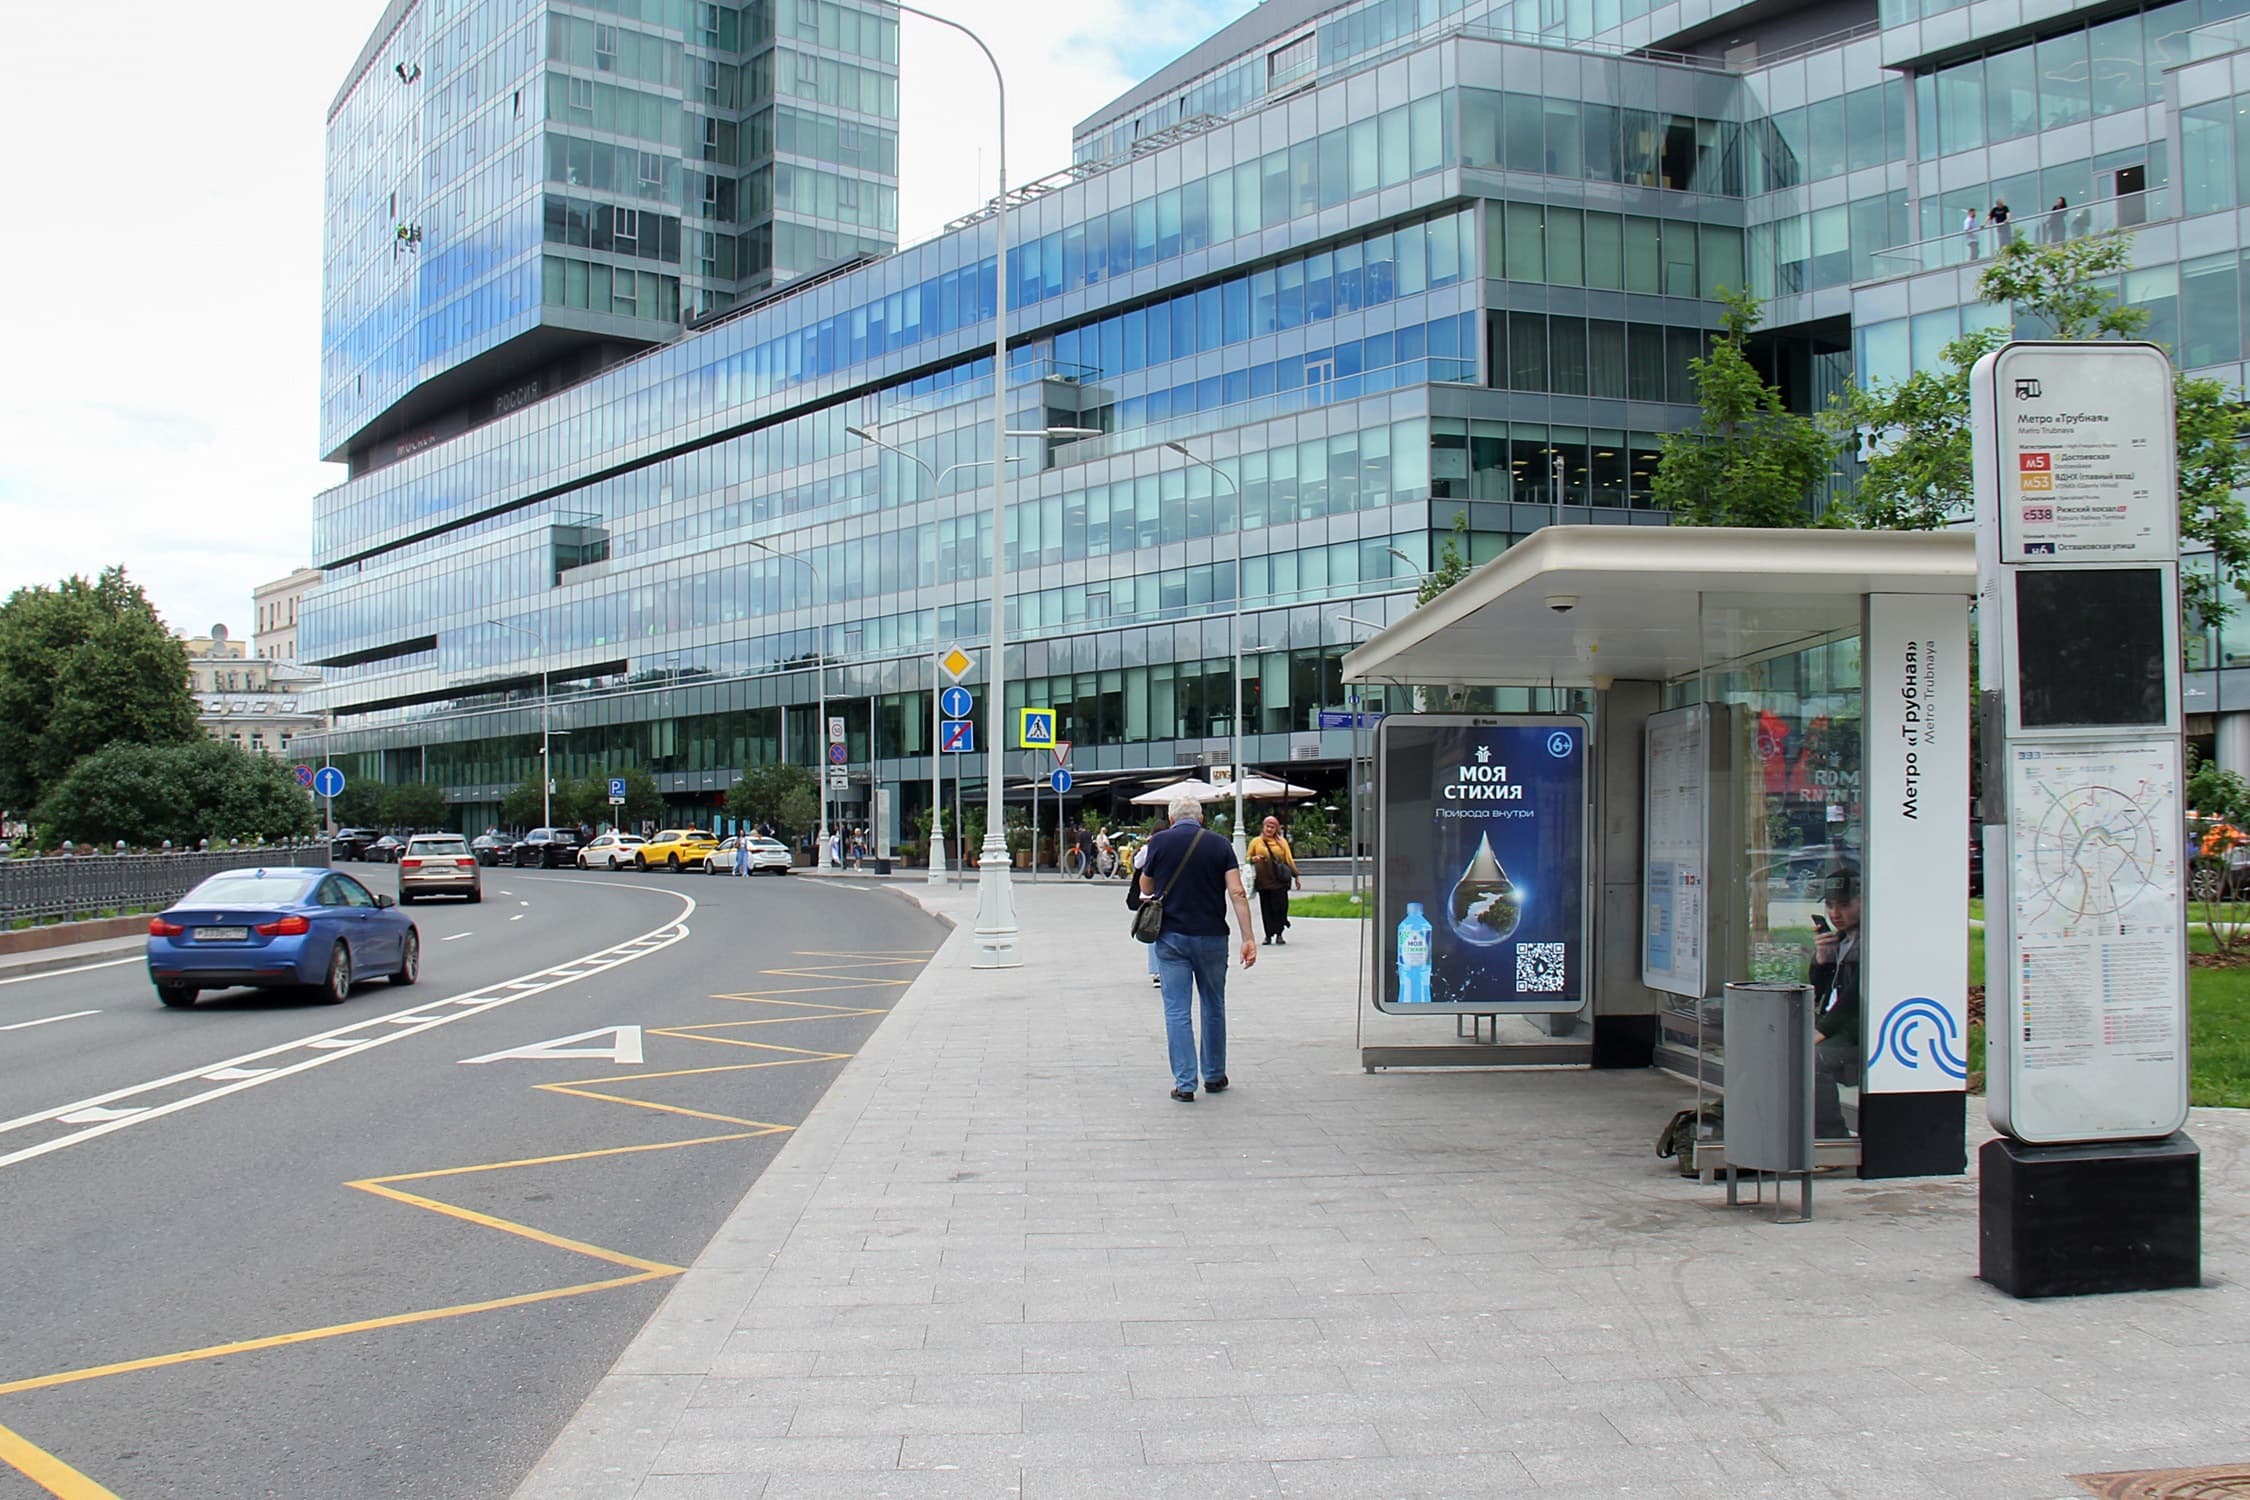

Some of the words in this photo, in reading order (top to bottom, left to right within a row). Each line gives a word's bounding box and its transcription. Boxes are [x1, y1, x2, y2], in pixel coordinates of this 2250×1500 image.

[496, 381, 538, 416] РОССИЯ
[2017, 414, 2053, 424] Метро
[2055, 413, 2109, 424] «Трубная»
[2026, 456, 2045, 468] м5
[2023, 476, 2049, 488] м53
[2023, 509, 2053, 520] с538
[1923, 640, 1936, 700] Trubnaya
[1901, 640, 1920, 747] «Трубная»
[1923, 703, 1935, 744] Metro
[1552, 738, 1570, 752] 6+
[1459, 766, 1506, 782] МОЯ
[1444, 785, 1523, 800] СТИХИЯ
[1902, 752, 1920, 819] Метро
[1435, 808, 1490, 818] Природа
[1492, 809, 1535, 819] внутри
